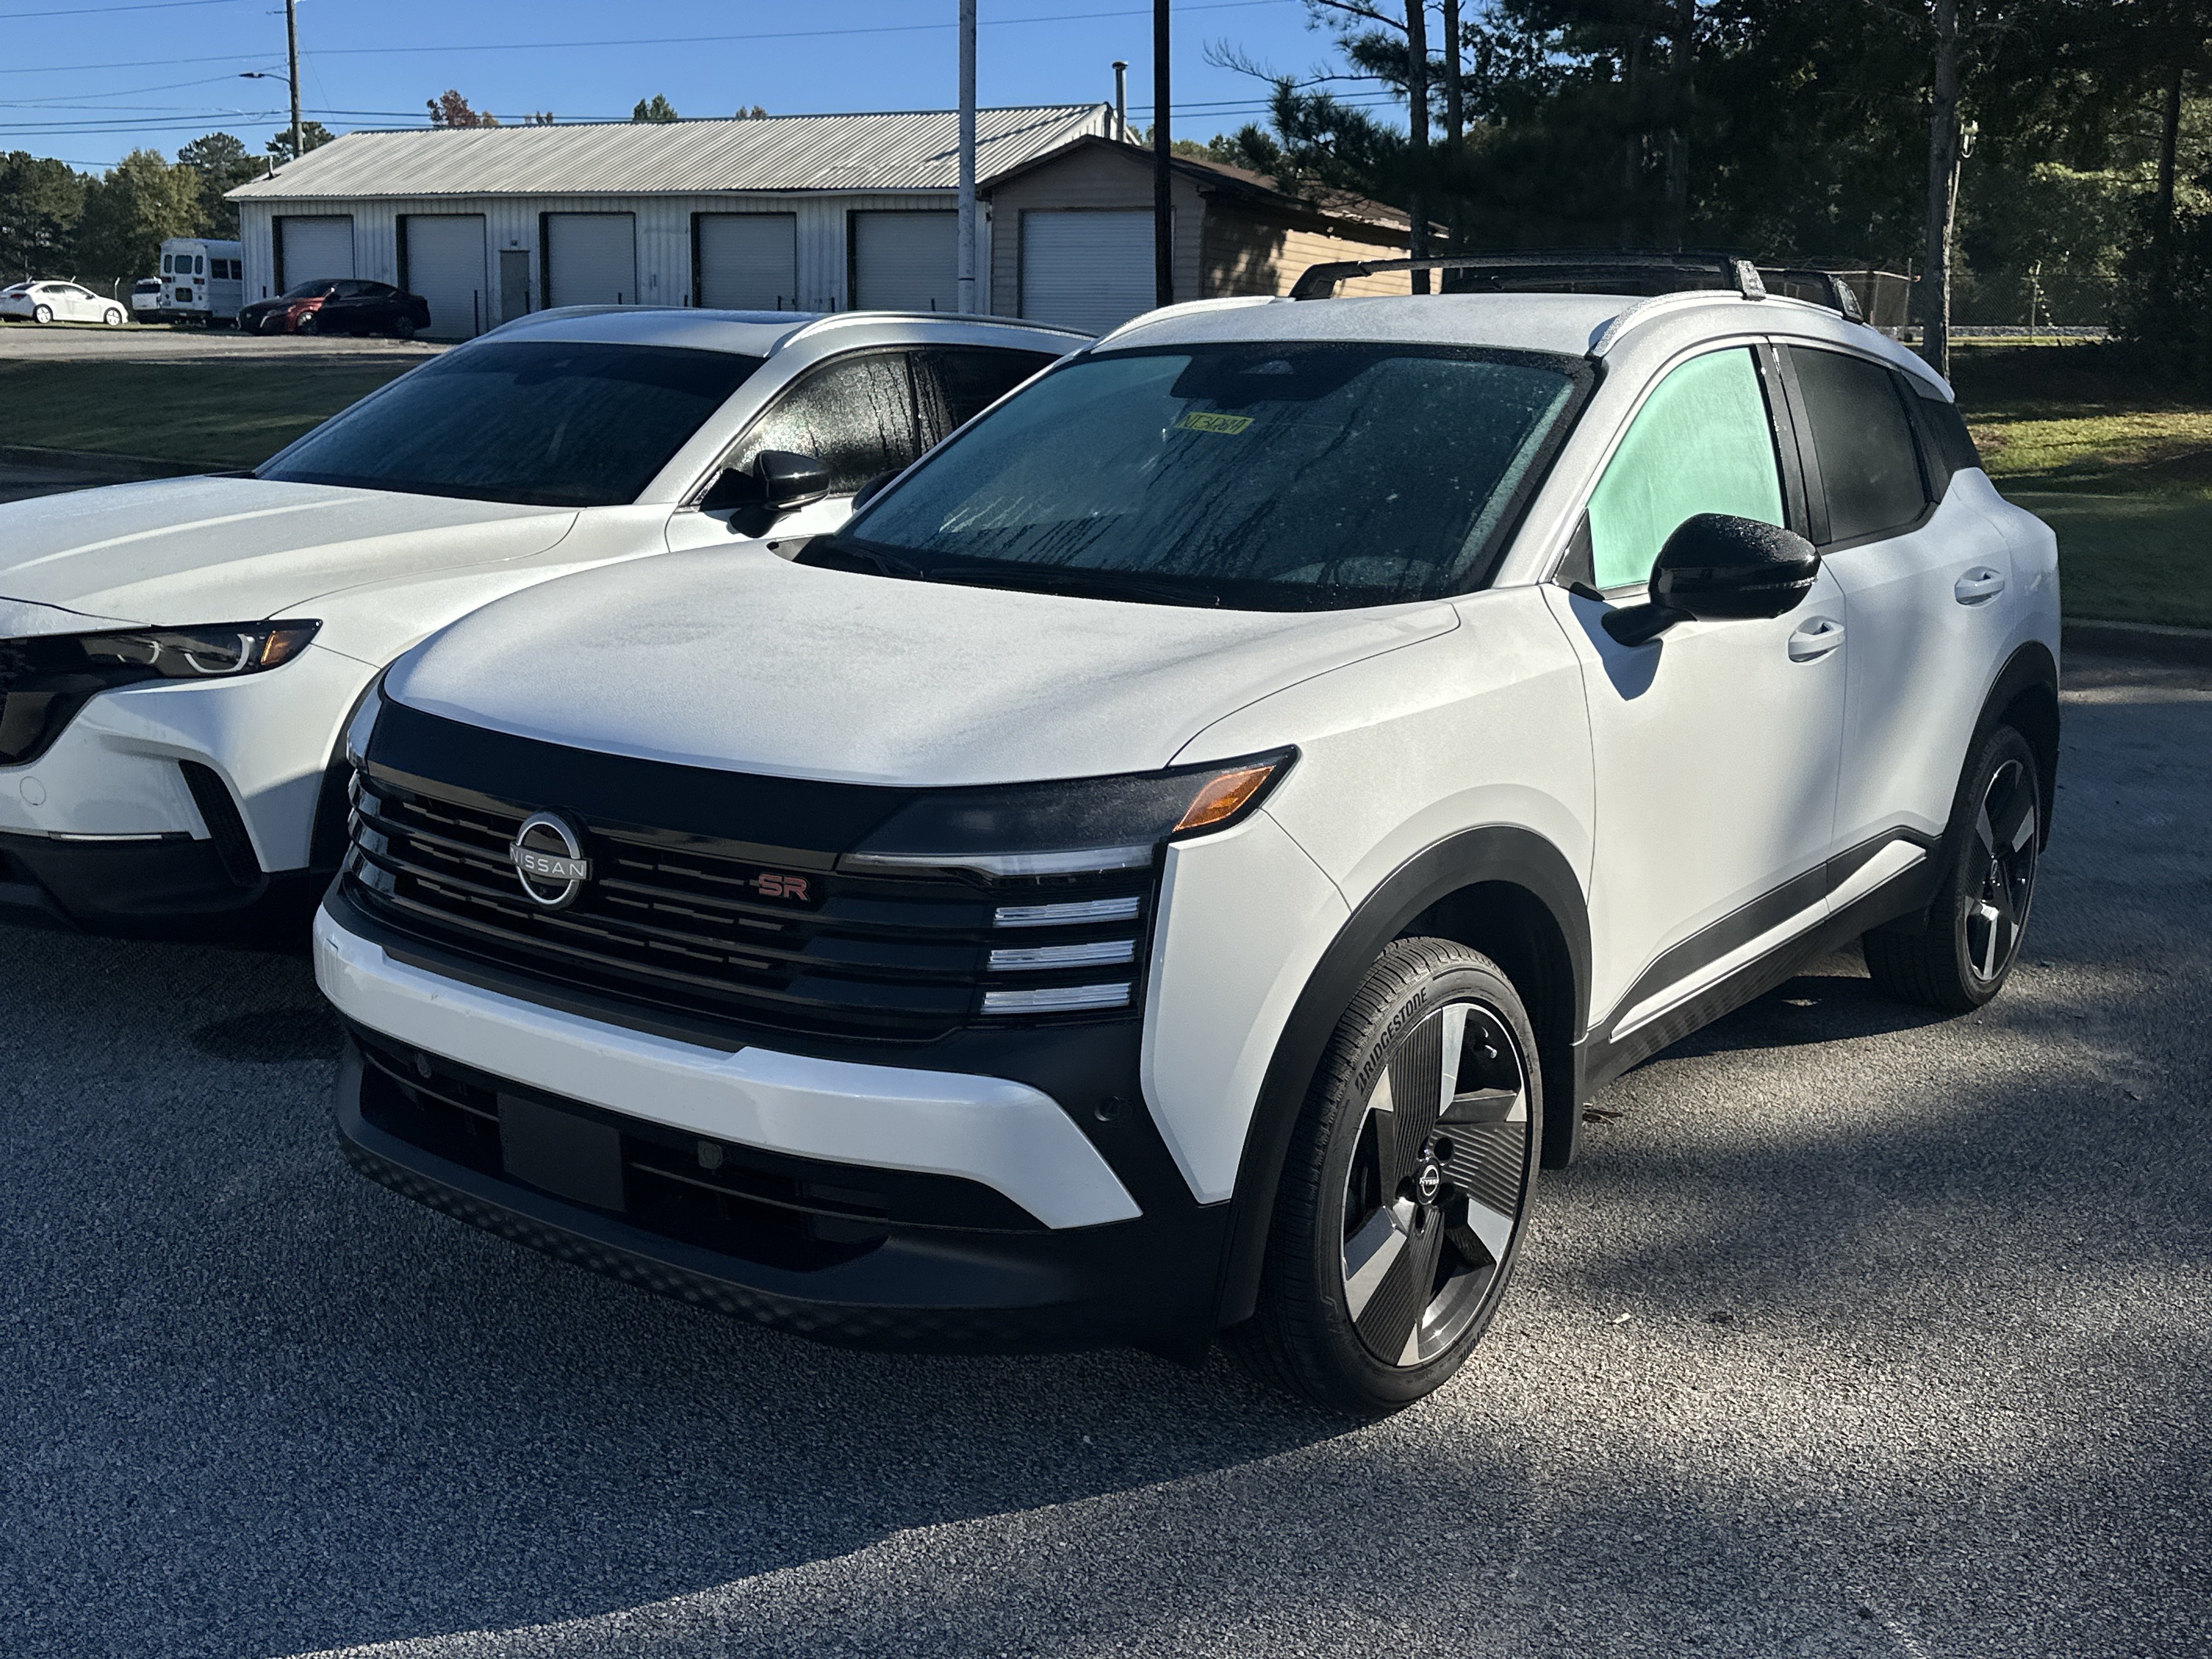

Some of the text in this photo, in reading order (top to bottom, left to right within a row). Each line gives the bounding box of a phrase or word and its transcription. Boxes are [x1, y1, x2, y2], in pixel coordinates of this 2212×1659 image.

[510, 847, 584, 877] NISSAN
[758, 873, 808, 900] SR
[1355, 986, 1427, 1096] BRIDGESTONE
